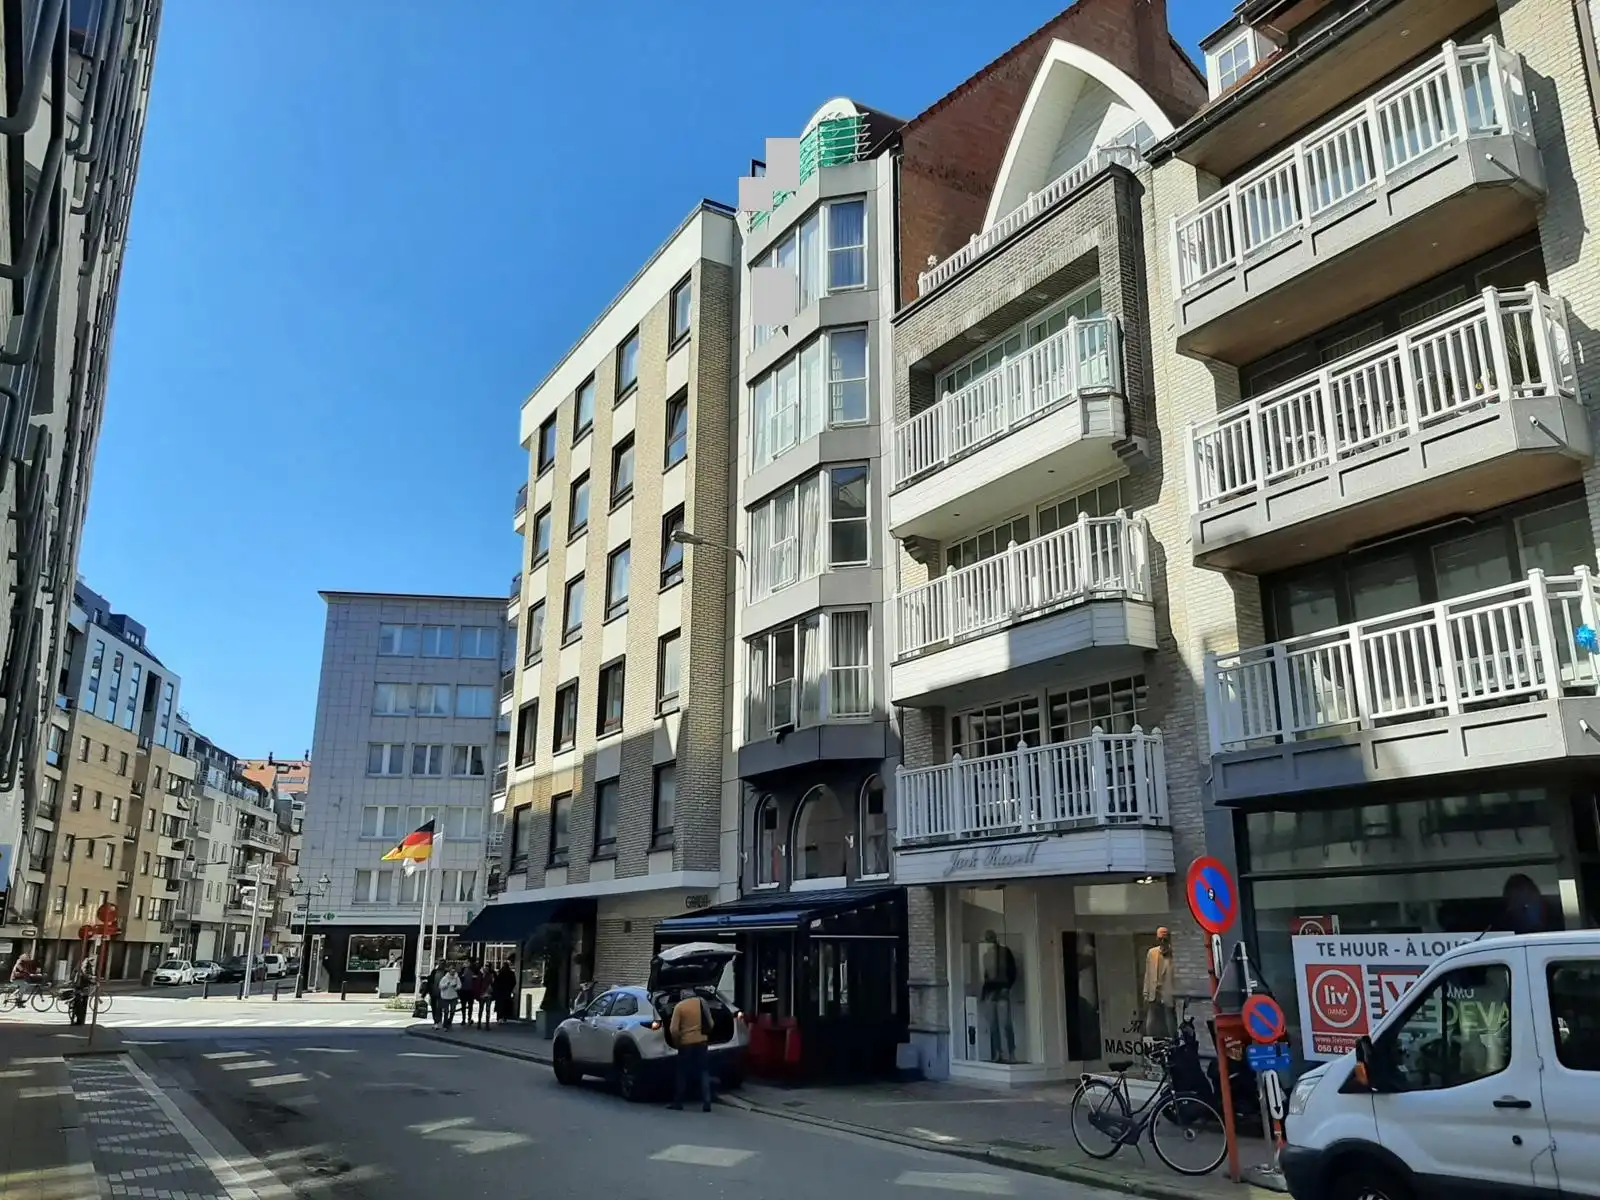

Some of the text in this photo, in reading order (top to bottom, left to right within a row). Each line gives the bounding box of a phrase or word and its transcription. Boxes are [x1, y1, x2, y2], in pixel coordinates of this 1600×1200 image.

[1316, 942, 1336, 957] TE
[1340, 942, 1389, 957] HUUR
[1405, 938, 1418, 957] À
[1422, 941, 1469, 957] LOU
[1327, 1008, 1348, 1016] IMMO
